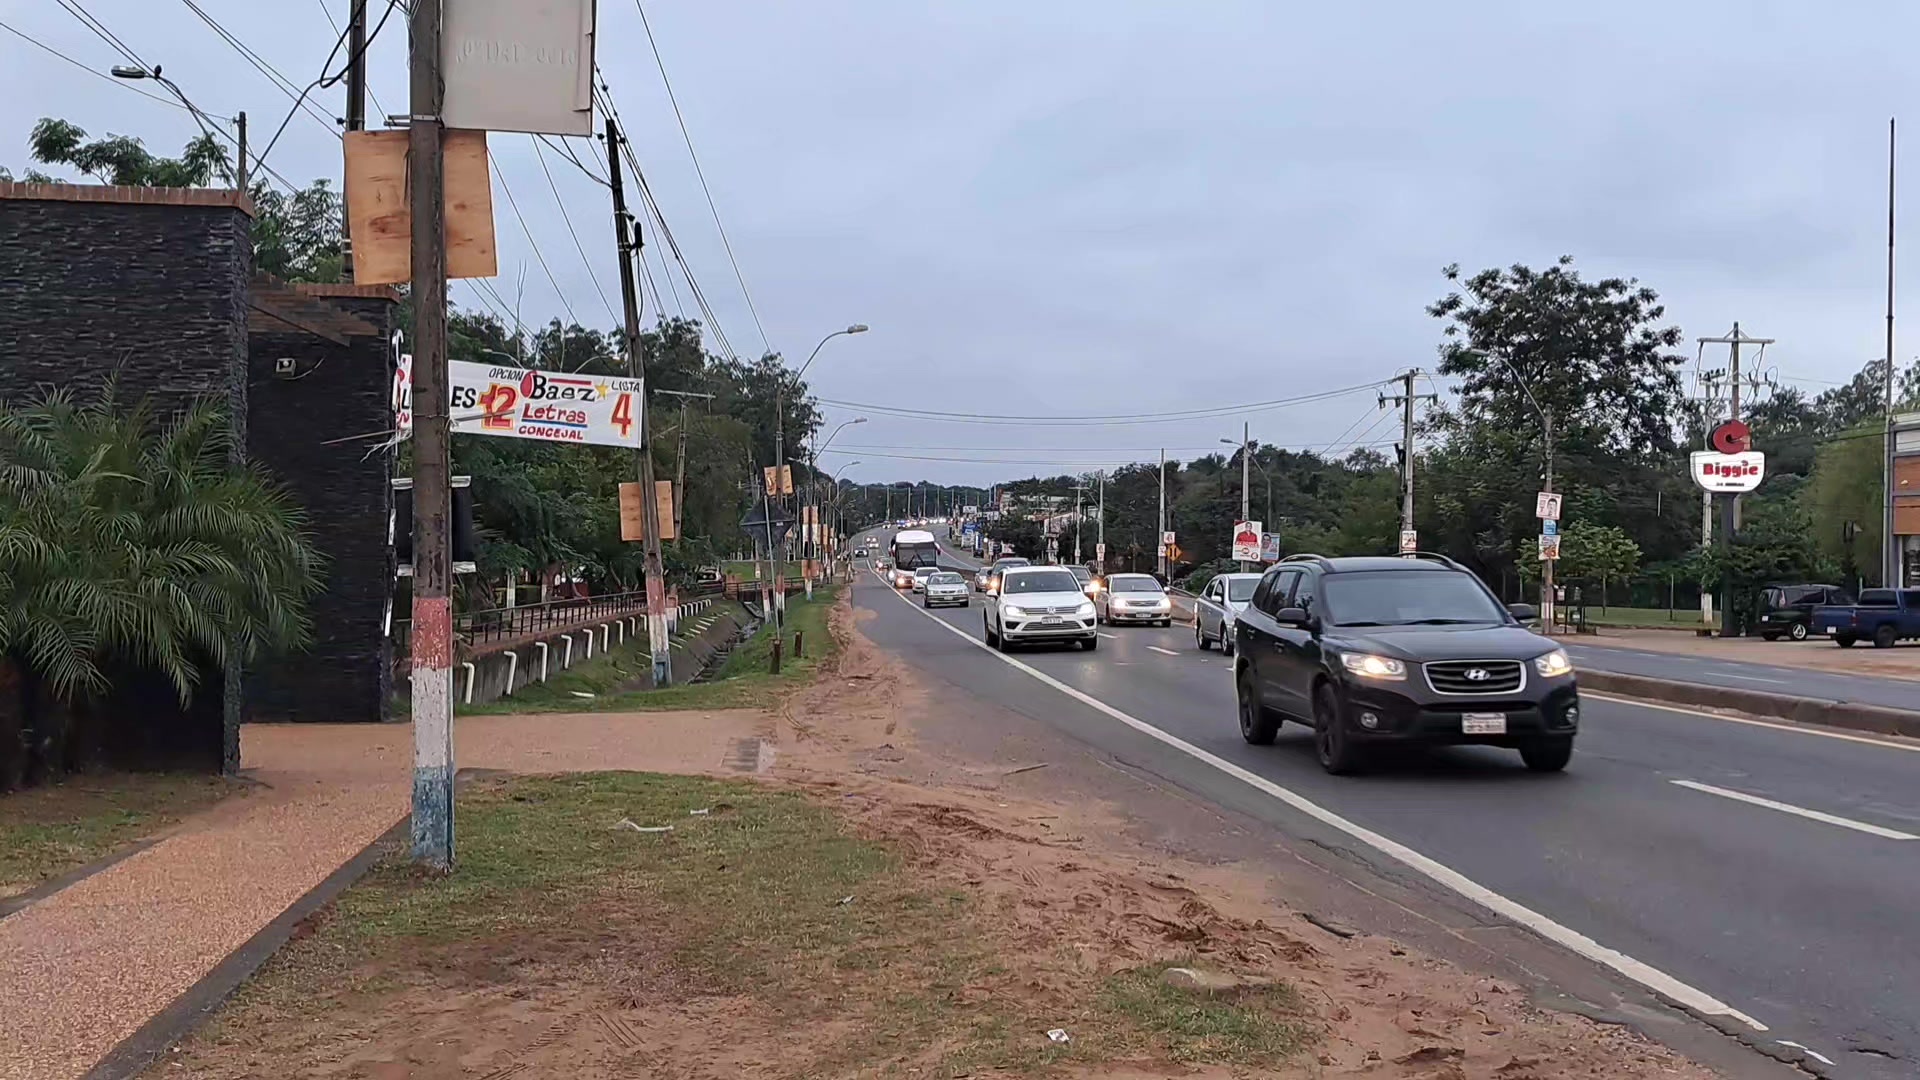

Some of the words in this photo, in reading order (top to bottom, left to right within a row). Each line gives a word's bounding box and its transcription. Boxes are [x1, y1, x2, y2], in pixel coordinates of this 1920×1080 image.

[489, 367, 524, 381] OPCION
[528, 374, 595, 402] Baez
[611, 380, 640, 393] LISTA
[479, 383, 517, 428] 12
[522, 403, 586, 424] Letras
[611, 393, 632, 436] 4
[519, 425, 583, 440] CONCEJAL
[1703, 460, 1758, 478] Biggie
